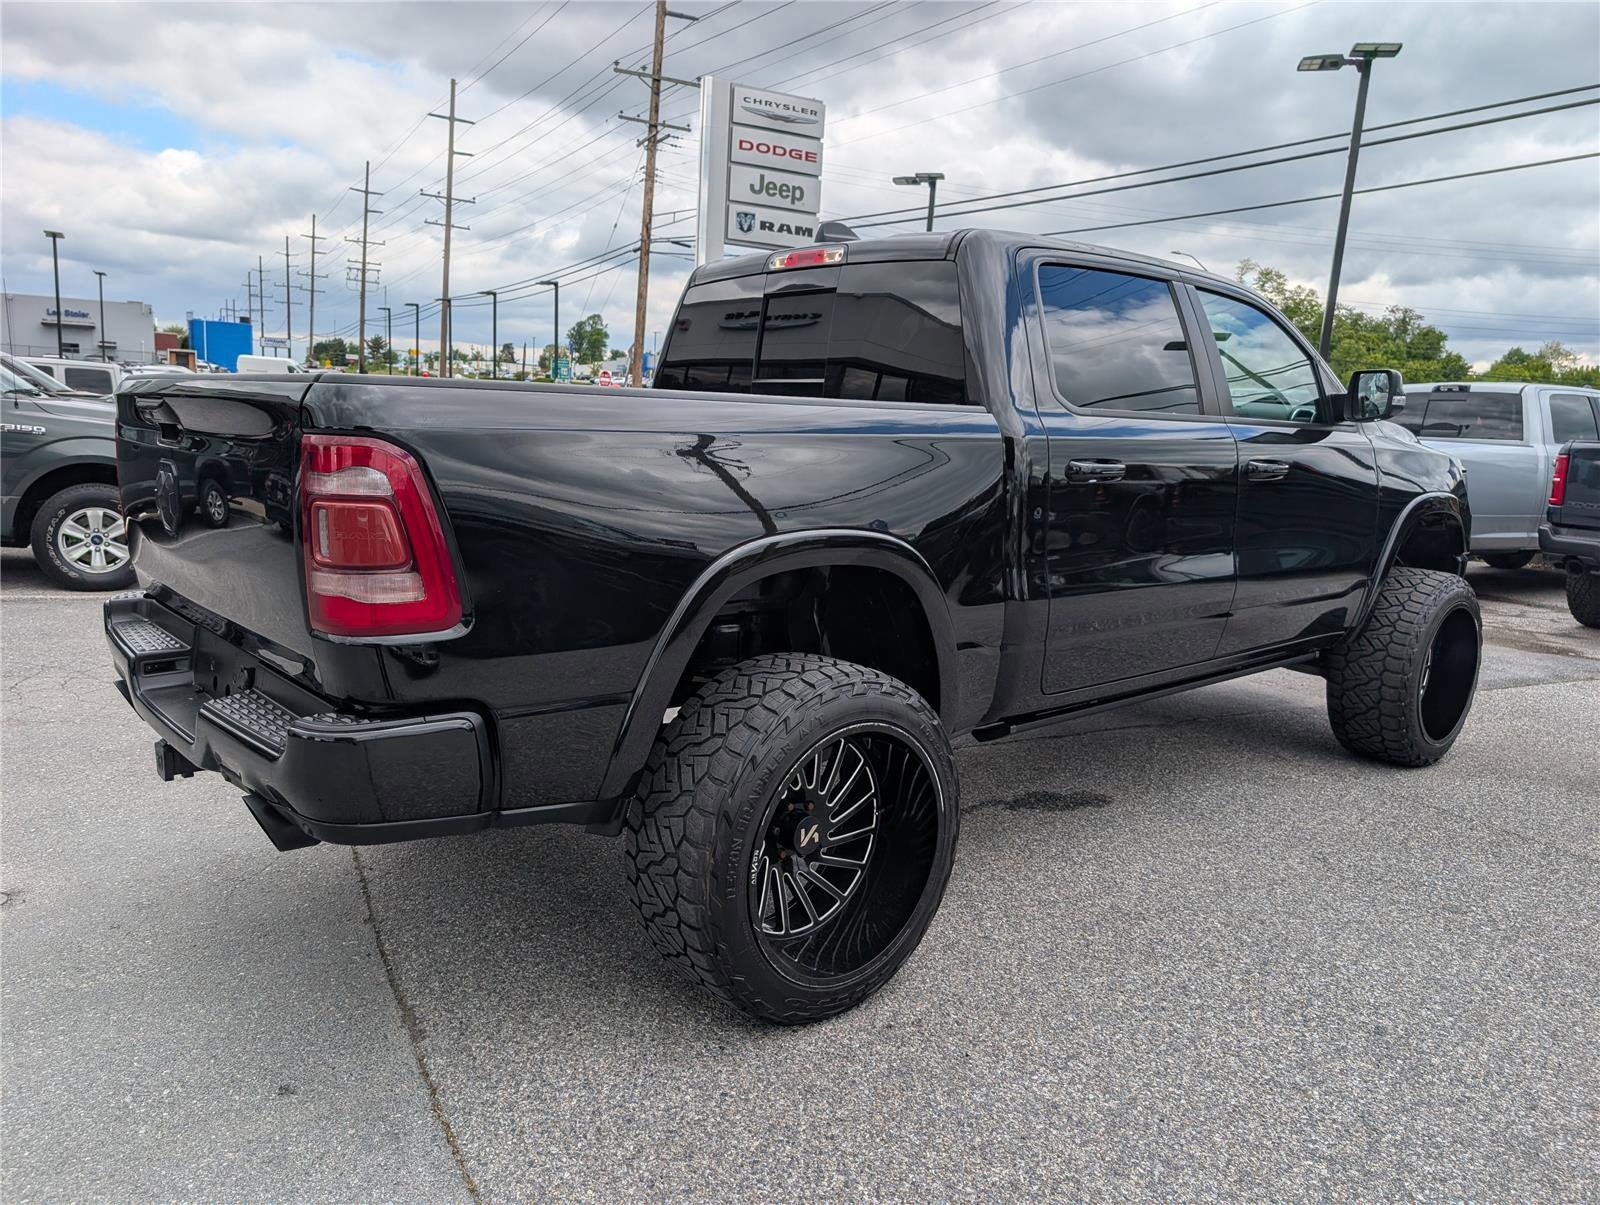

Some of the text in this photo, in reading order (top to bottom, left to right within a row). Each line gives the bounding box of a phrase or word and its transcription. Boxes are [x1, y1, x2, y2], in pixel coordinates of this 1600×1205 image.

[743, 96, 818, 117] CHRYSLER
[738, 139, 818, 163] DODGE
[749, 173, 805, 205] Jeep
[759, 220, 813, 238] RAM
